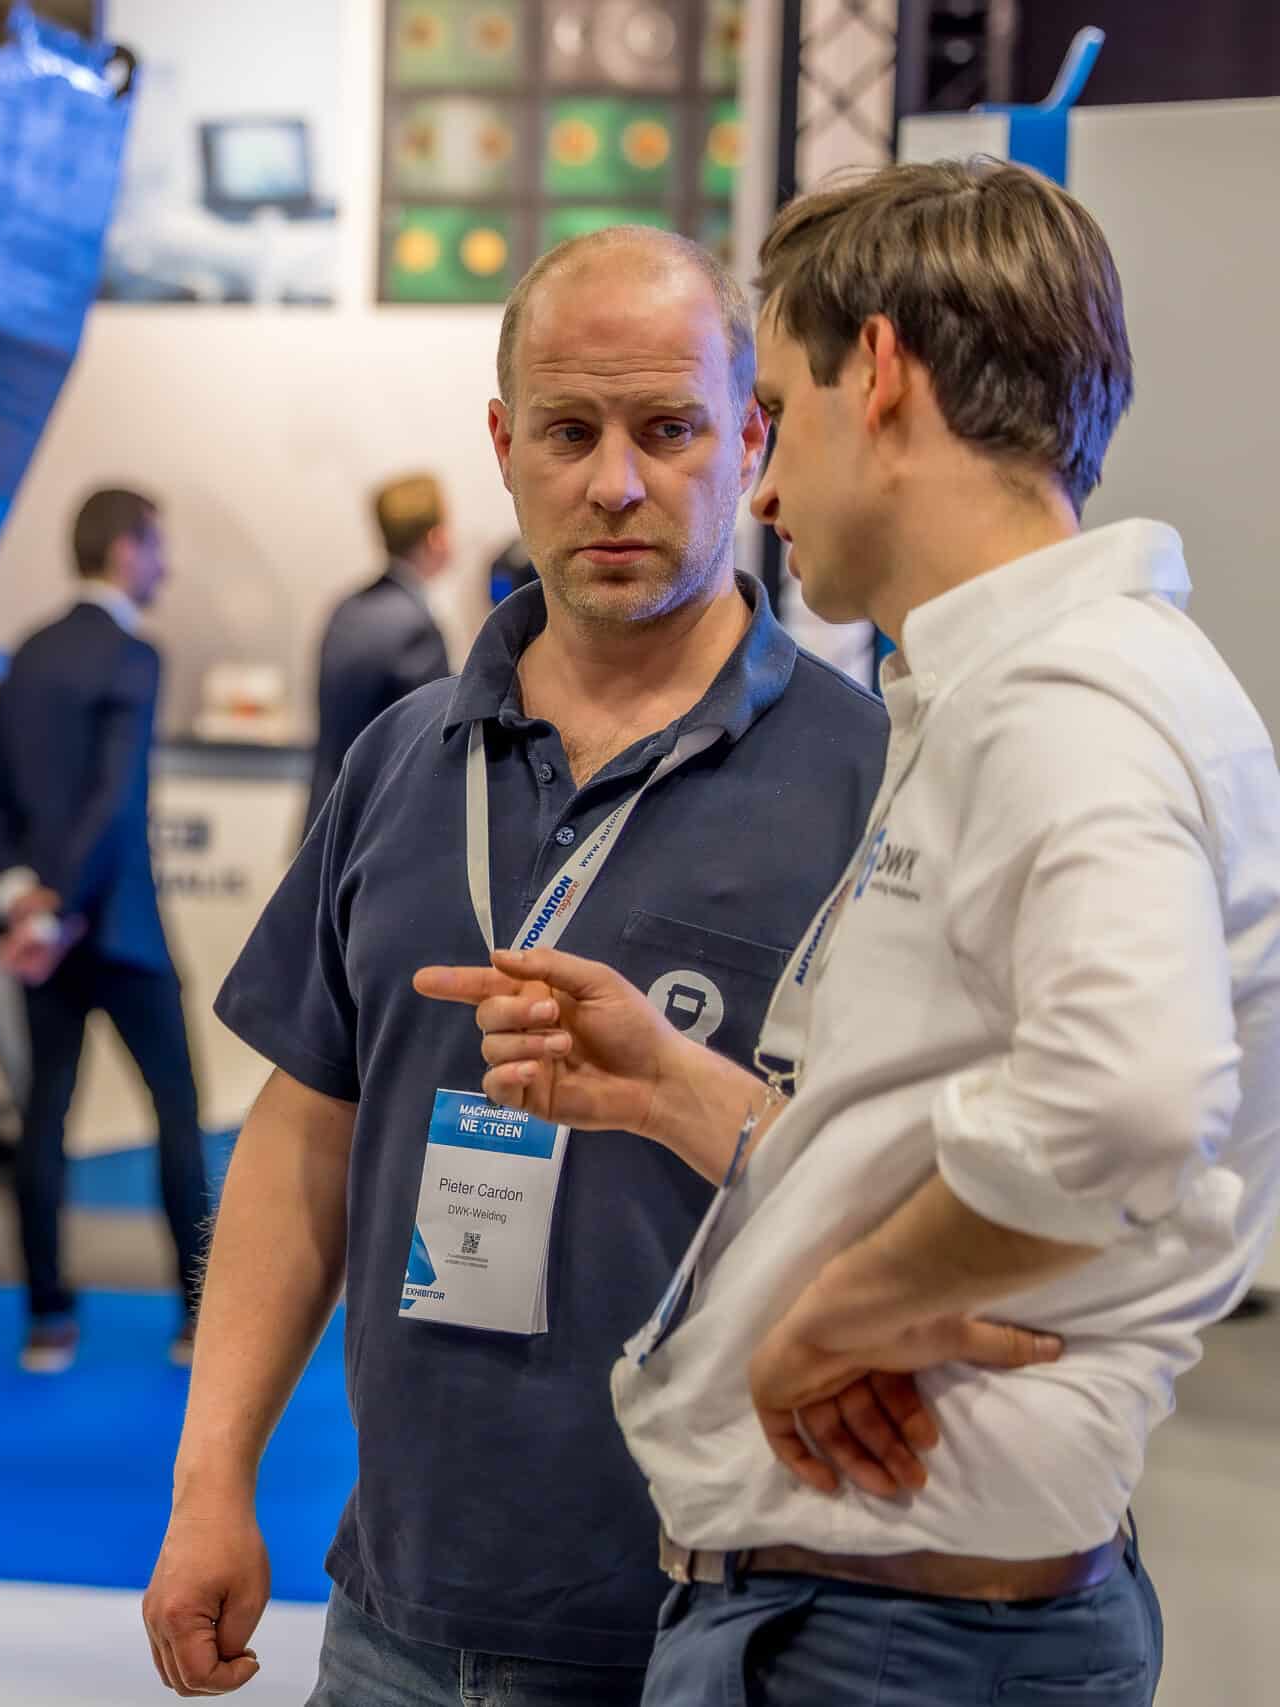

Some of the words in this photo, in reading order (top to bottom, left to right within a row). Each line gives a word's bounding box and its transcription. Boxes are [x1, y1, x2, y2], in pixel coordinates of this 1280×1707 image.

[520, 875, 574, 950] TOMATION
[794, 879, 852, 986] AUTOMA
[459, 1103, 529, 1122] MACHINEERING
[439, 1177, 475, 1196] Pieter
[477, 1183, 523, 1202] Cardon
[447, 1204, 507, 1225] DWK-Welding
[406, 1287, 446, 1301] EXHIBITOR
